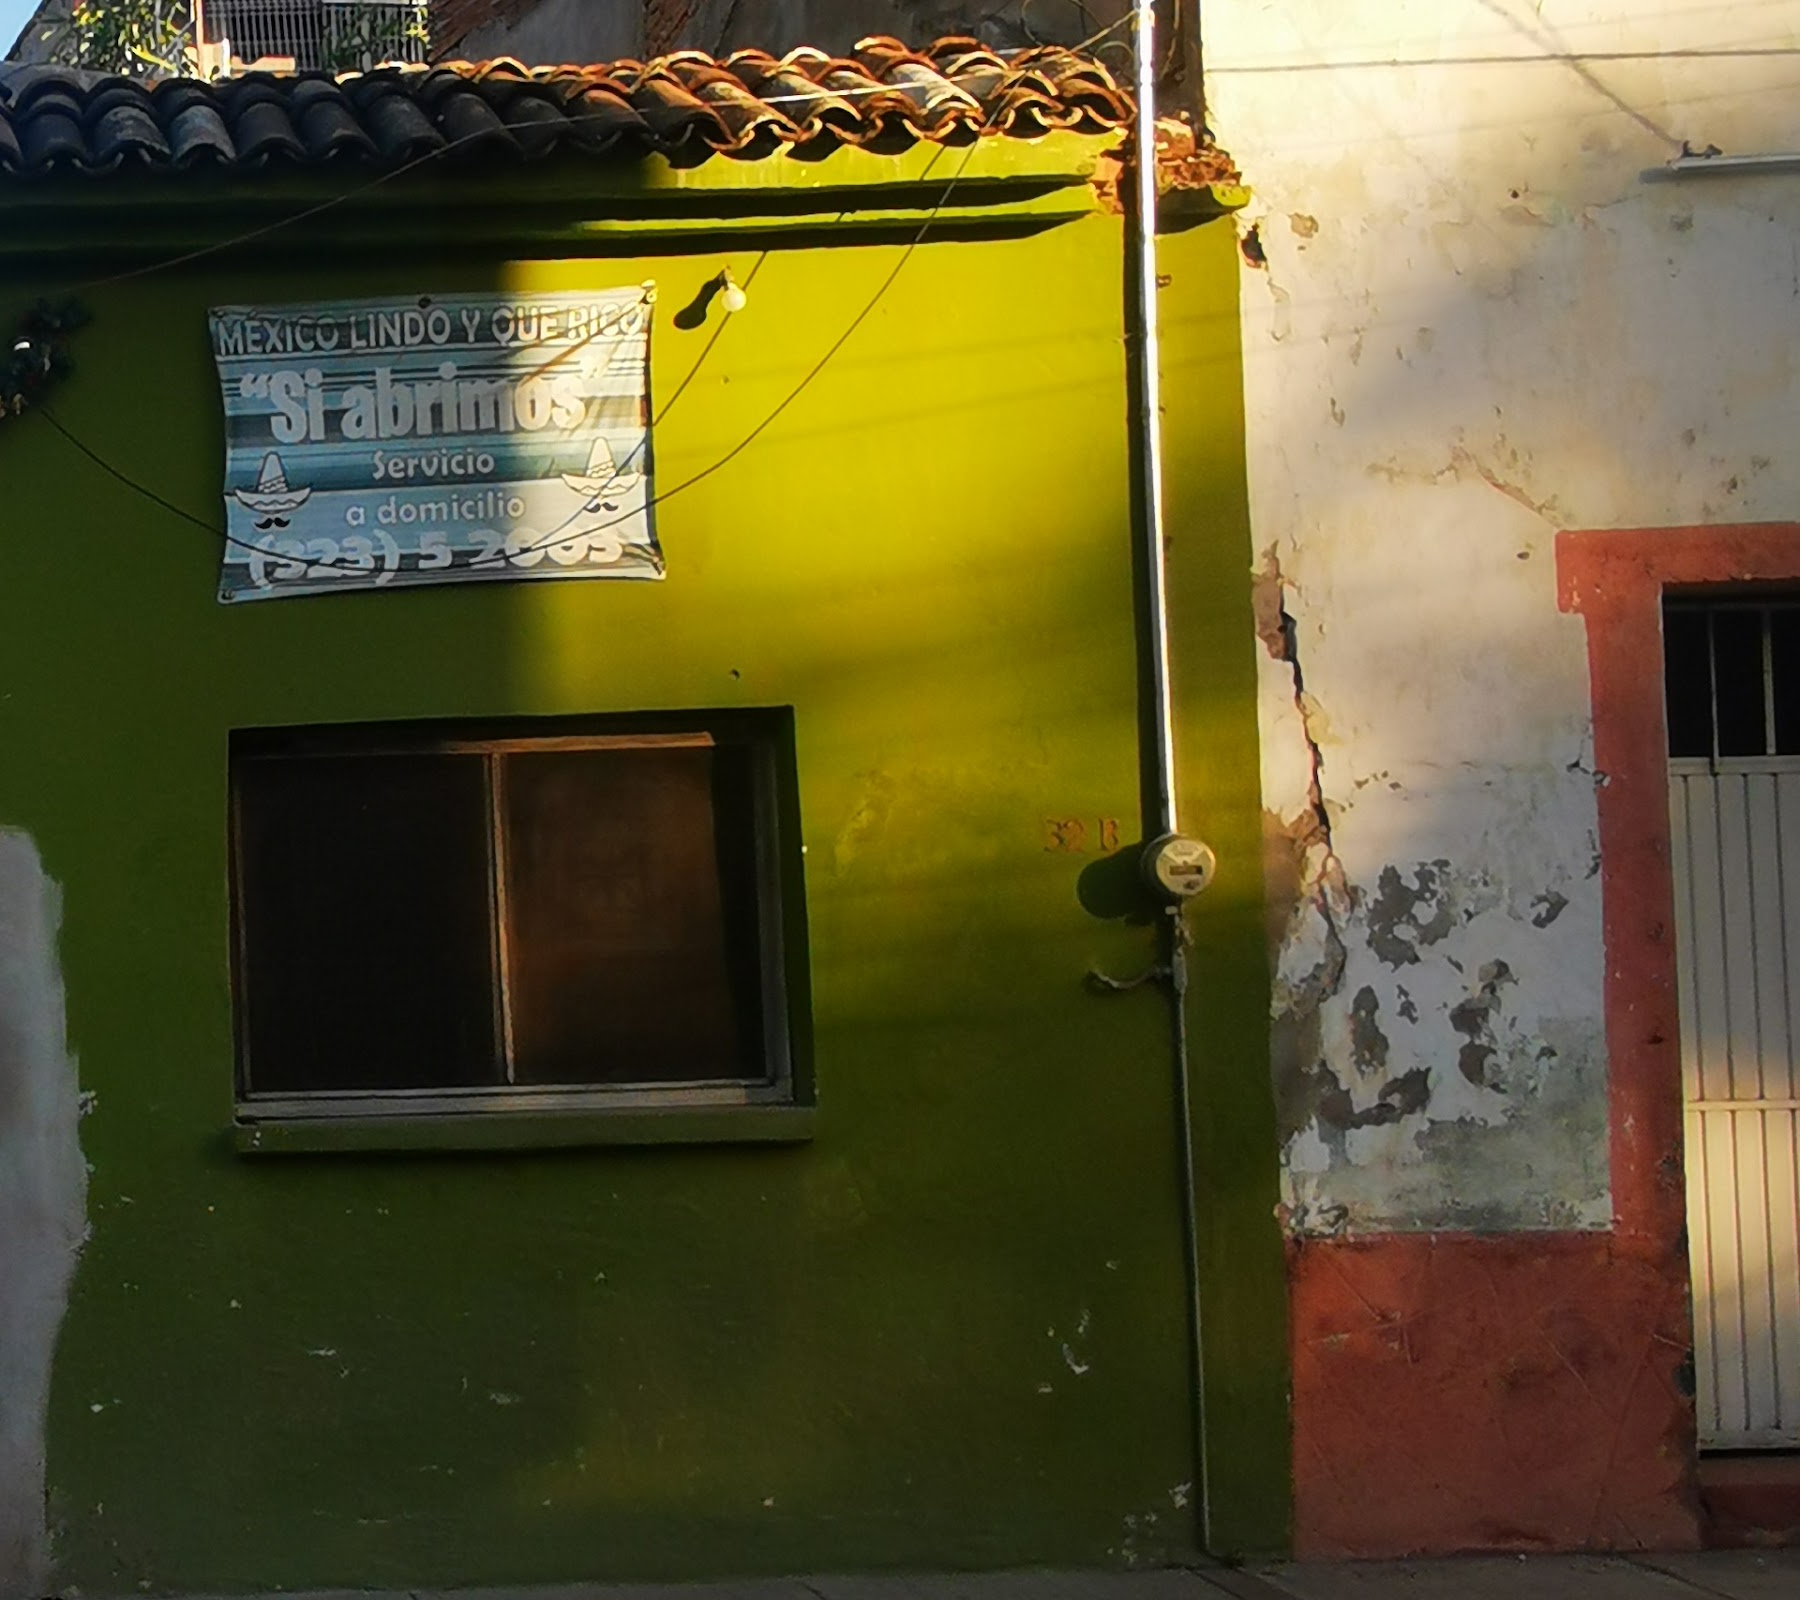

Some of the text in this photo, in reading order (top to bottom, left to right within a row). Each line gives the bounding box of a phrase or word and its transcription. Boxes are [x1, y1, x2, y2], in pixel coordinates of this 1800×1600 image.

[350, 309, 451, 348] LINDO
[461, 308, 481, 343] Y
[492, 306, 558, 347] QUE
[372, 448, 495, 480] Servicio
[346, 491, 526, 527] a domicilio
[418, 531, 452, 569] 5
